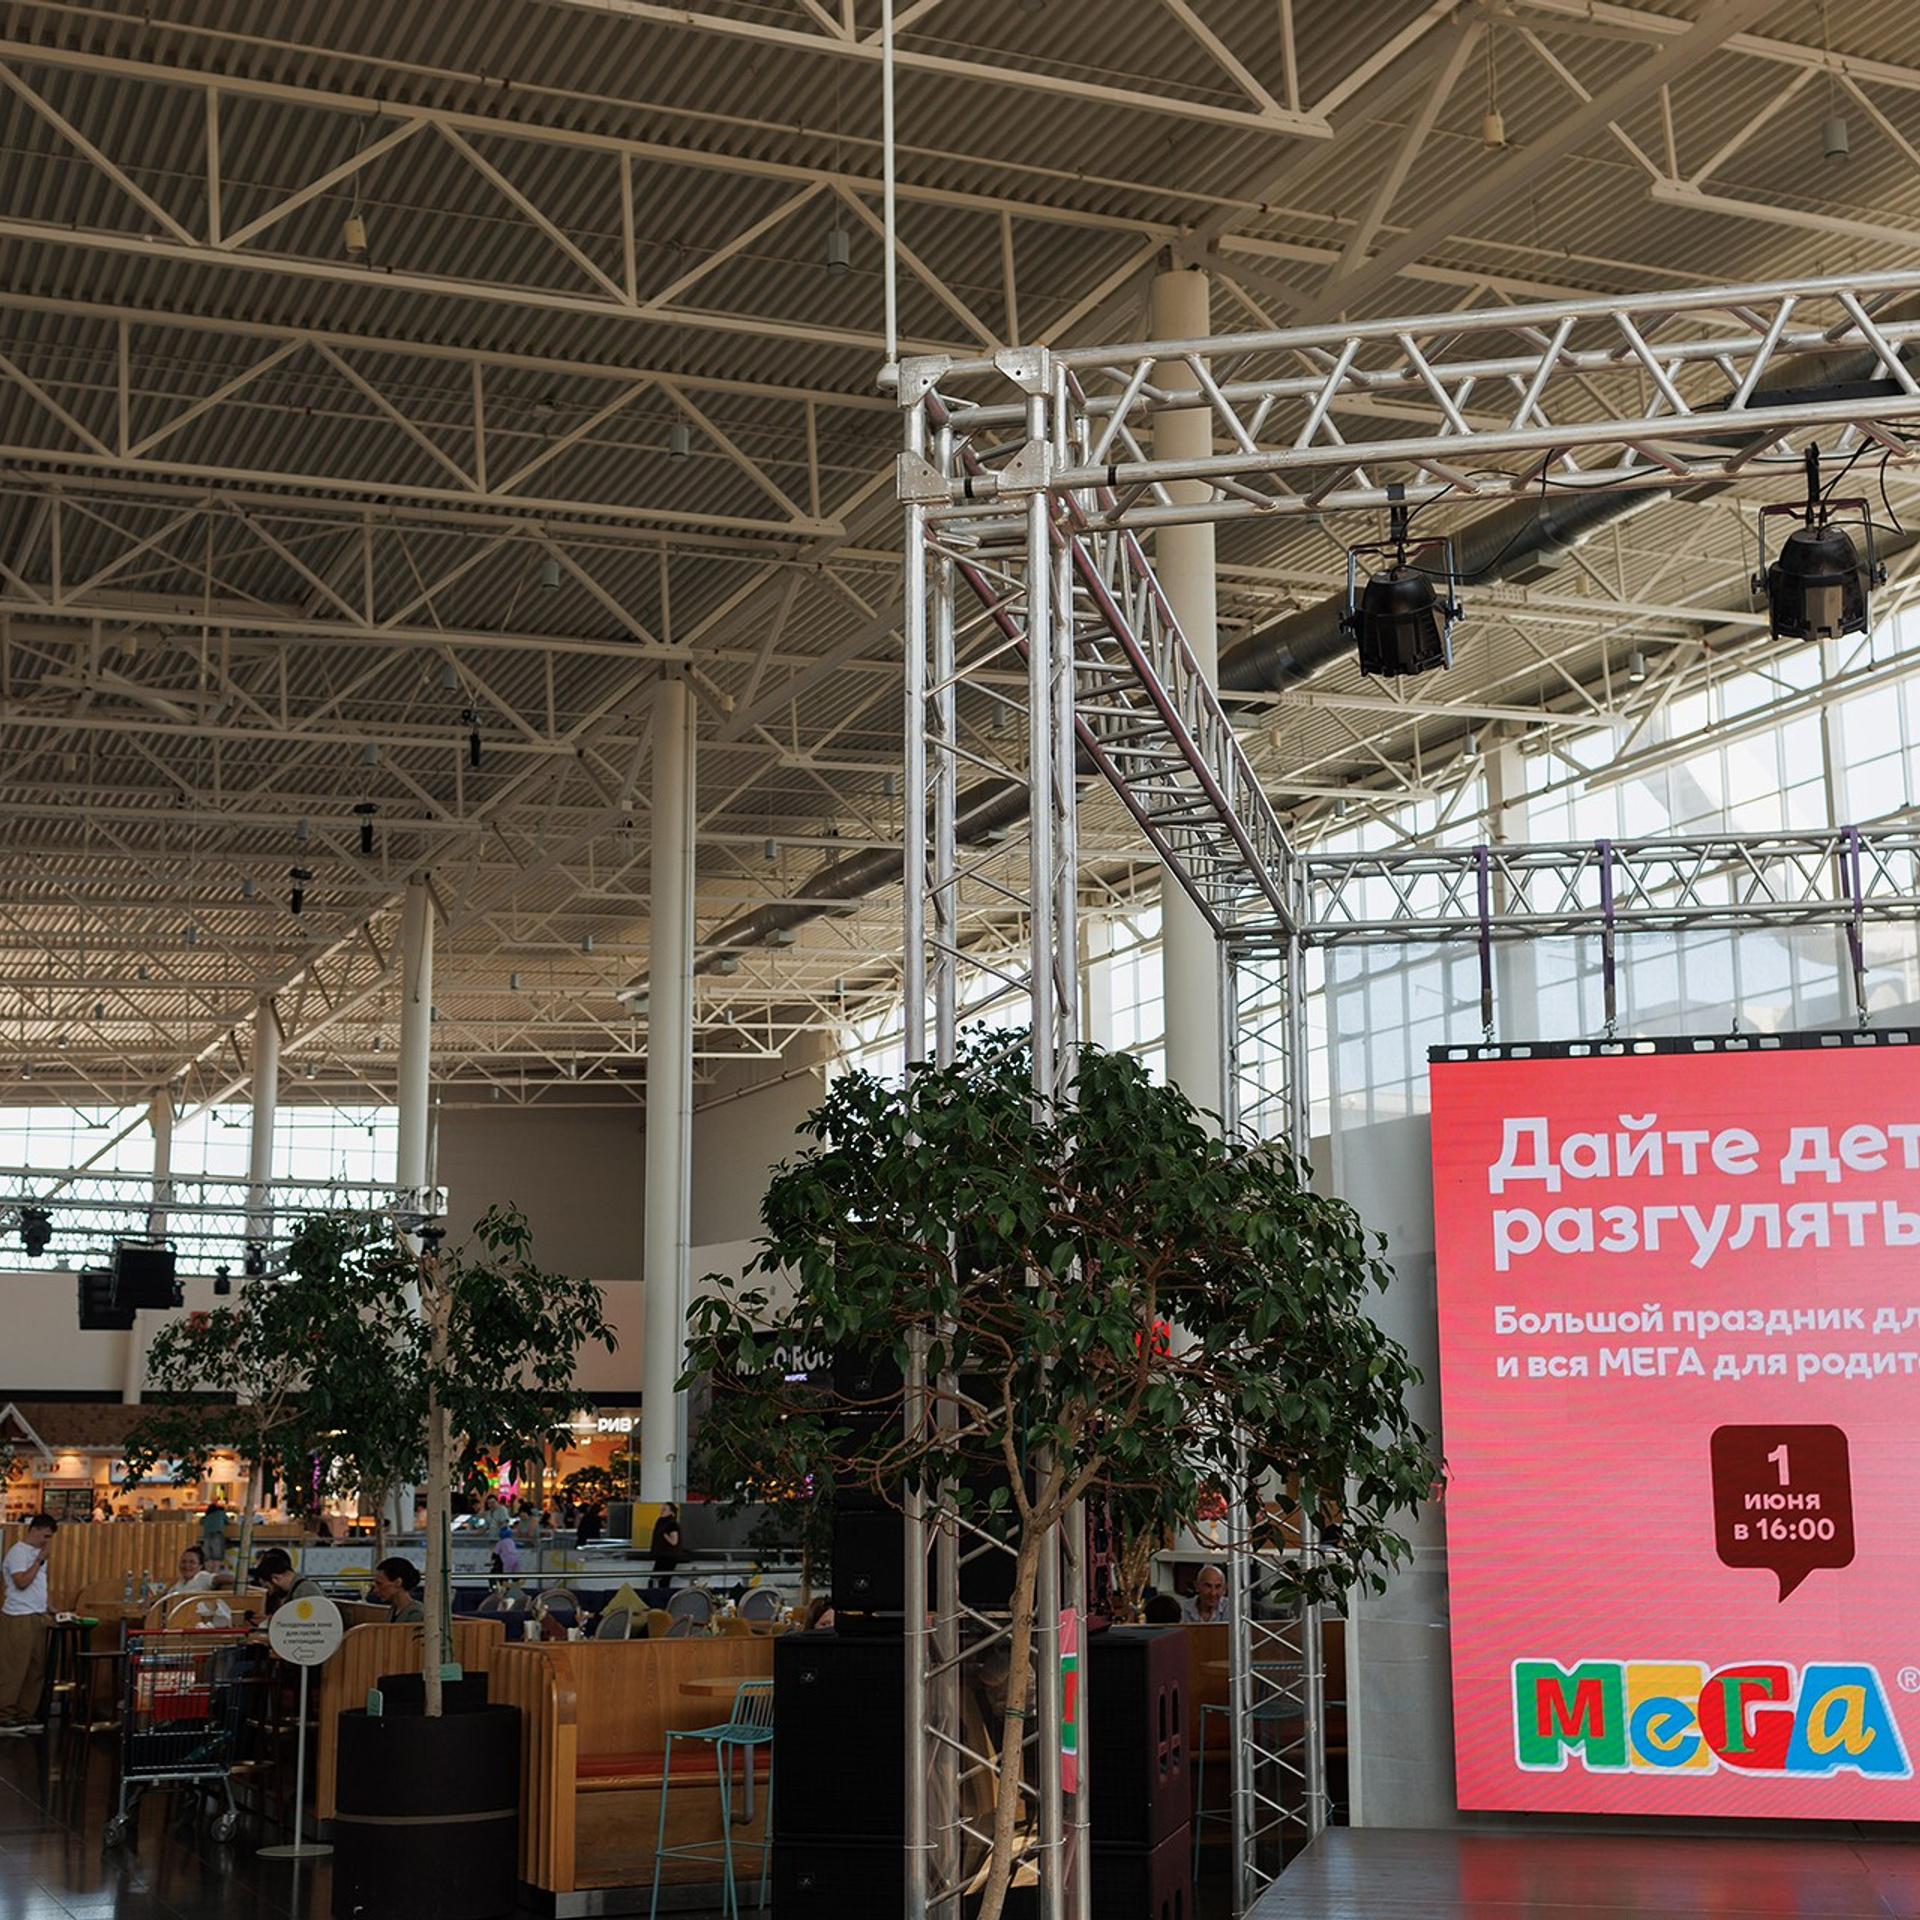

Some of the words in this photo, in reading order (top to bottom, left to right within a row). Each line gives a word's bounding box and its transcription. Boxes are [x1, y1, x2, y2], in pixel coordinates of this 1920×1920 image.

[1488, 1113, 1760, 1194] Дайте
[1492, 1200, 1920, 1271] разгулять
[1494, 1302, 1664, 1335] Большой
[1672, 1308, 1866, 1339] праздник
[1496, 1357, 1518, 1377] и
[1528, 1355, 1588, 1378] вся
[1599, 1347, 1705, 1377] МЕГА
[1713, 1353, 1788, 1381] для
[1796, 1352, 1920, 1383] родит
[1766, 1444, 1791, 1487] 1
[1744, 1492, 1820, 1511] июня
[1733, 1522, 1749, 1540] в
[1756, 1517, 1835, 1541] 16:00
